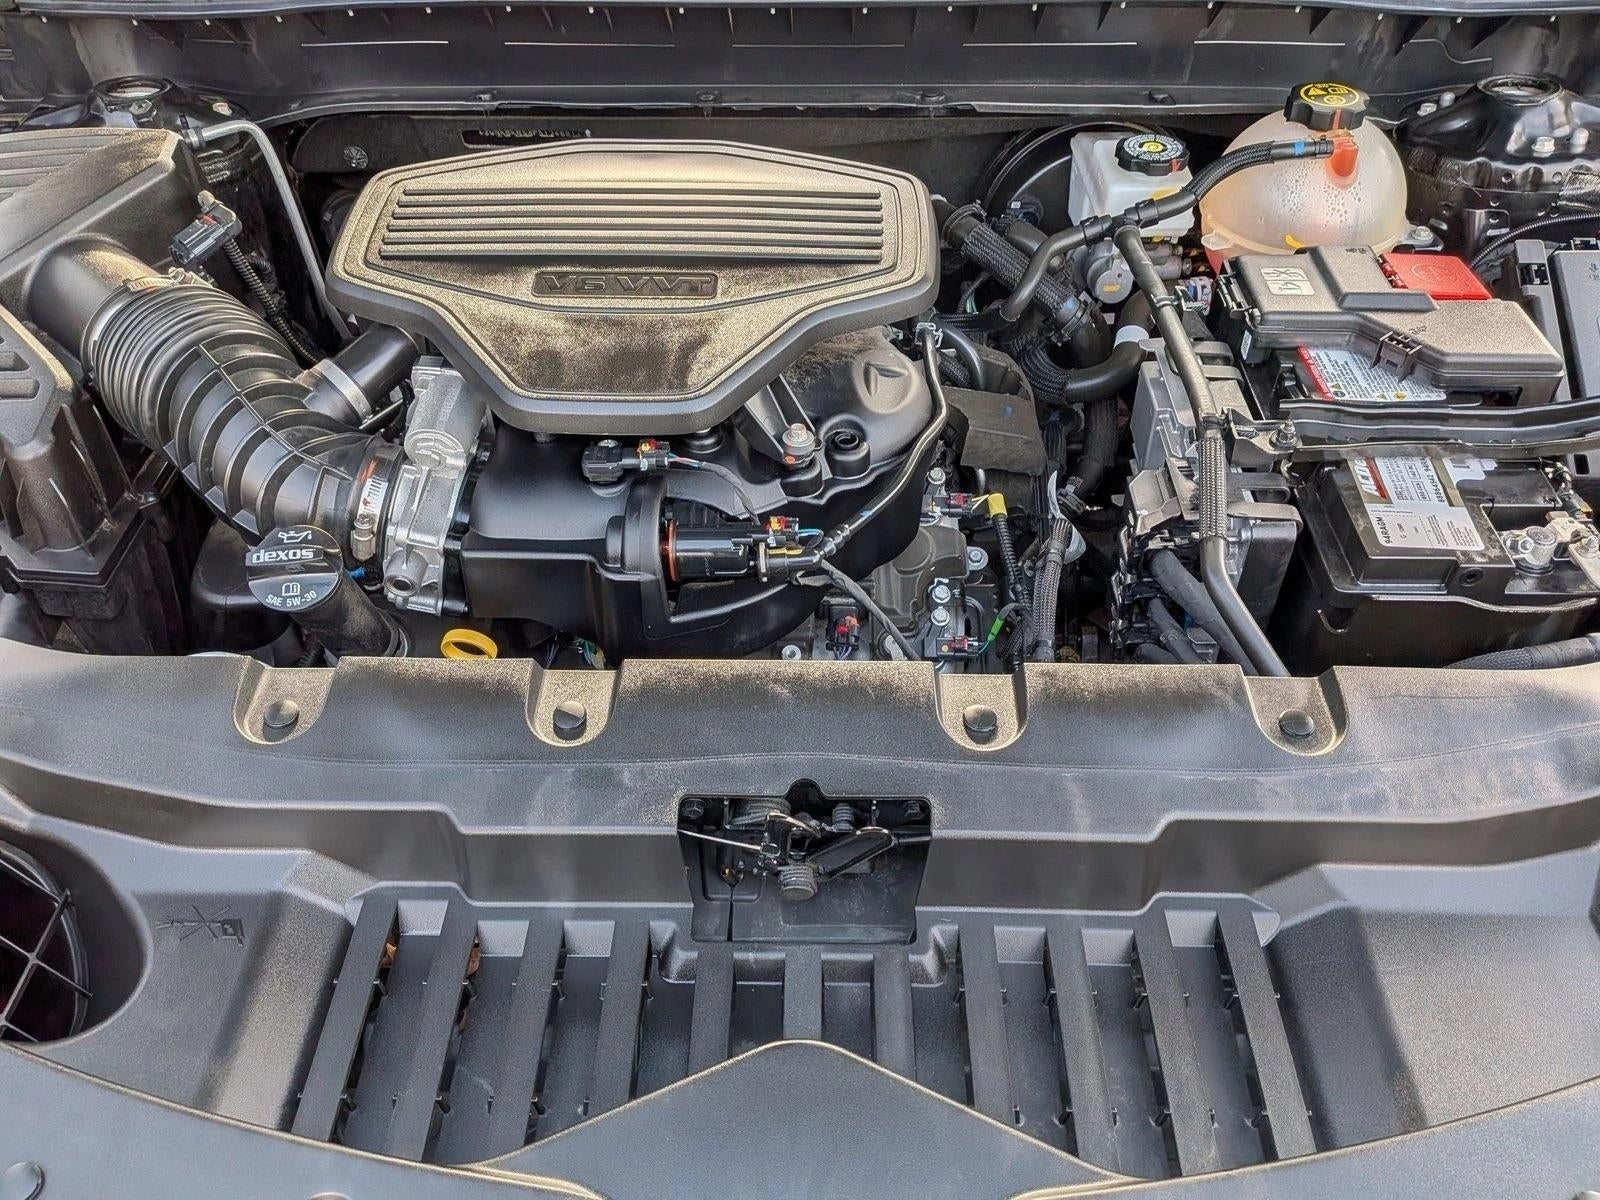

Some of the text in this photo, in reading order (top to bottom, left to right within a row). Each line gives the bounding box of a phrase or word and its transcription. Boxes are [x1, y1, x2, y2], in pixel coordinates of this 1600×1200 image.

[542, 275, 711, 293] V6 VVT
[1375, 516, 1393, 544] 94RAGM
[252, 549, 314, 563] dexos
[266, 590, 317, 607] SAE 5W-30
